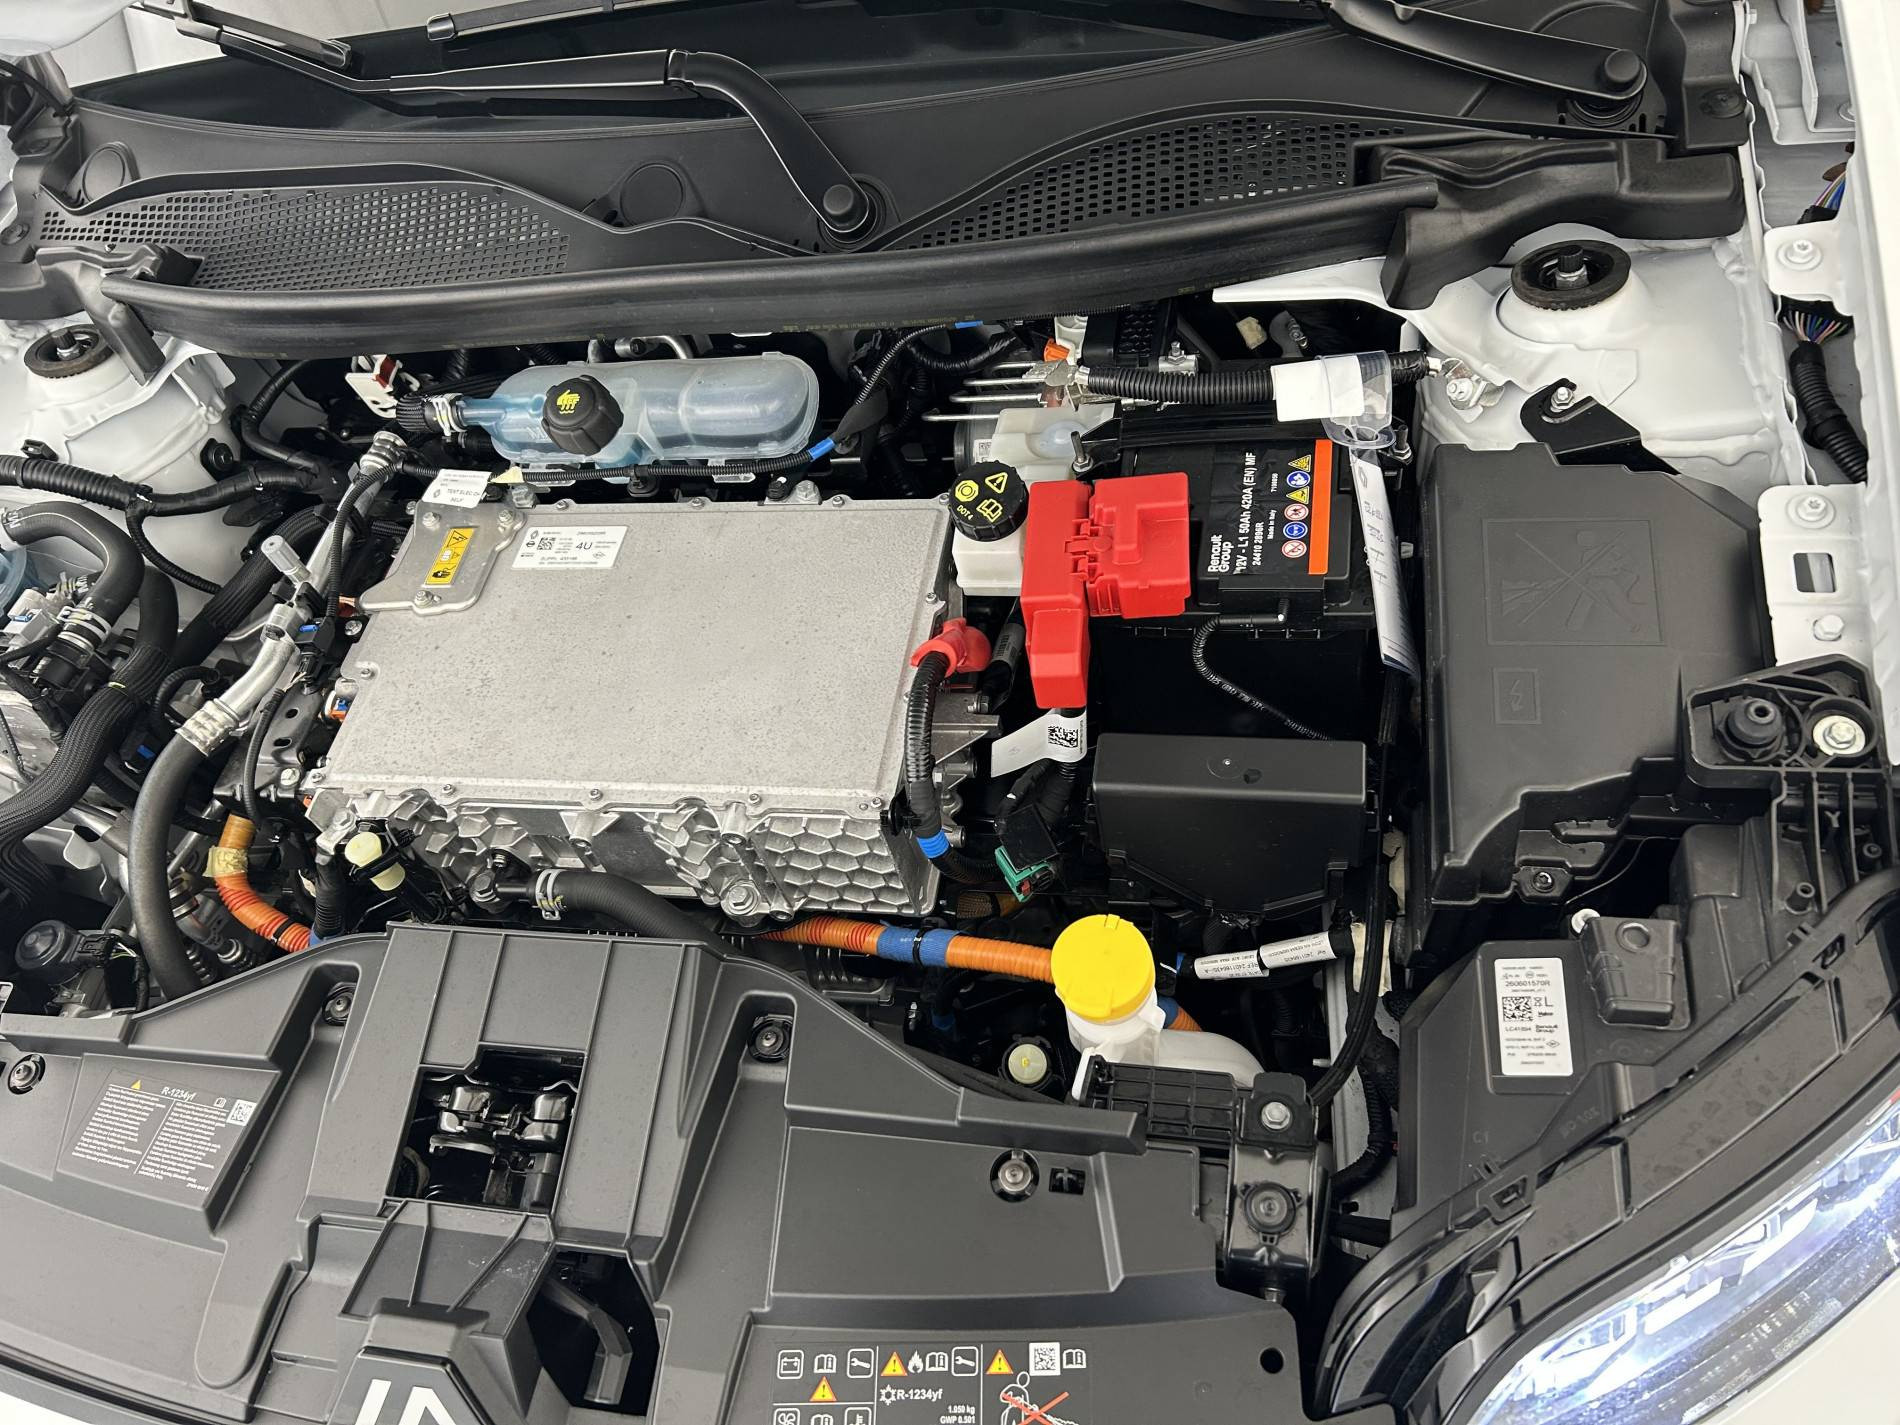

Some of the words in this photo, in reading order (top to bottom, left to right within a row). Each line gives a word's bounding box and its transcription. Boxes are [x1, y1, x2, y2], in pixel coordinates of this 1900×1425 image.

[1245, 452, 1256, 466] MF
[1243, 467, 1258, 486] (EN)
[1241, 487, 1253, 510] 420A
[1238, 511, 1252, 535] 50Ah
[575, 541, 593, 550] 4U
[1238, 536, 1249, 548] L1
[1207, 534, 1223, 573] Renault
[1218, 541, 1235, 573] Group
[1234, 555, 1248, 573] 12V
[896, 1388, 943, 1402] R-1234yf
[966, 1405, 975, 1415] kg
[940, 1415, 957, 1424] GWP
[958, 1415, 976, 1424] 0.501
